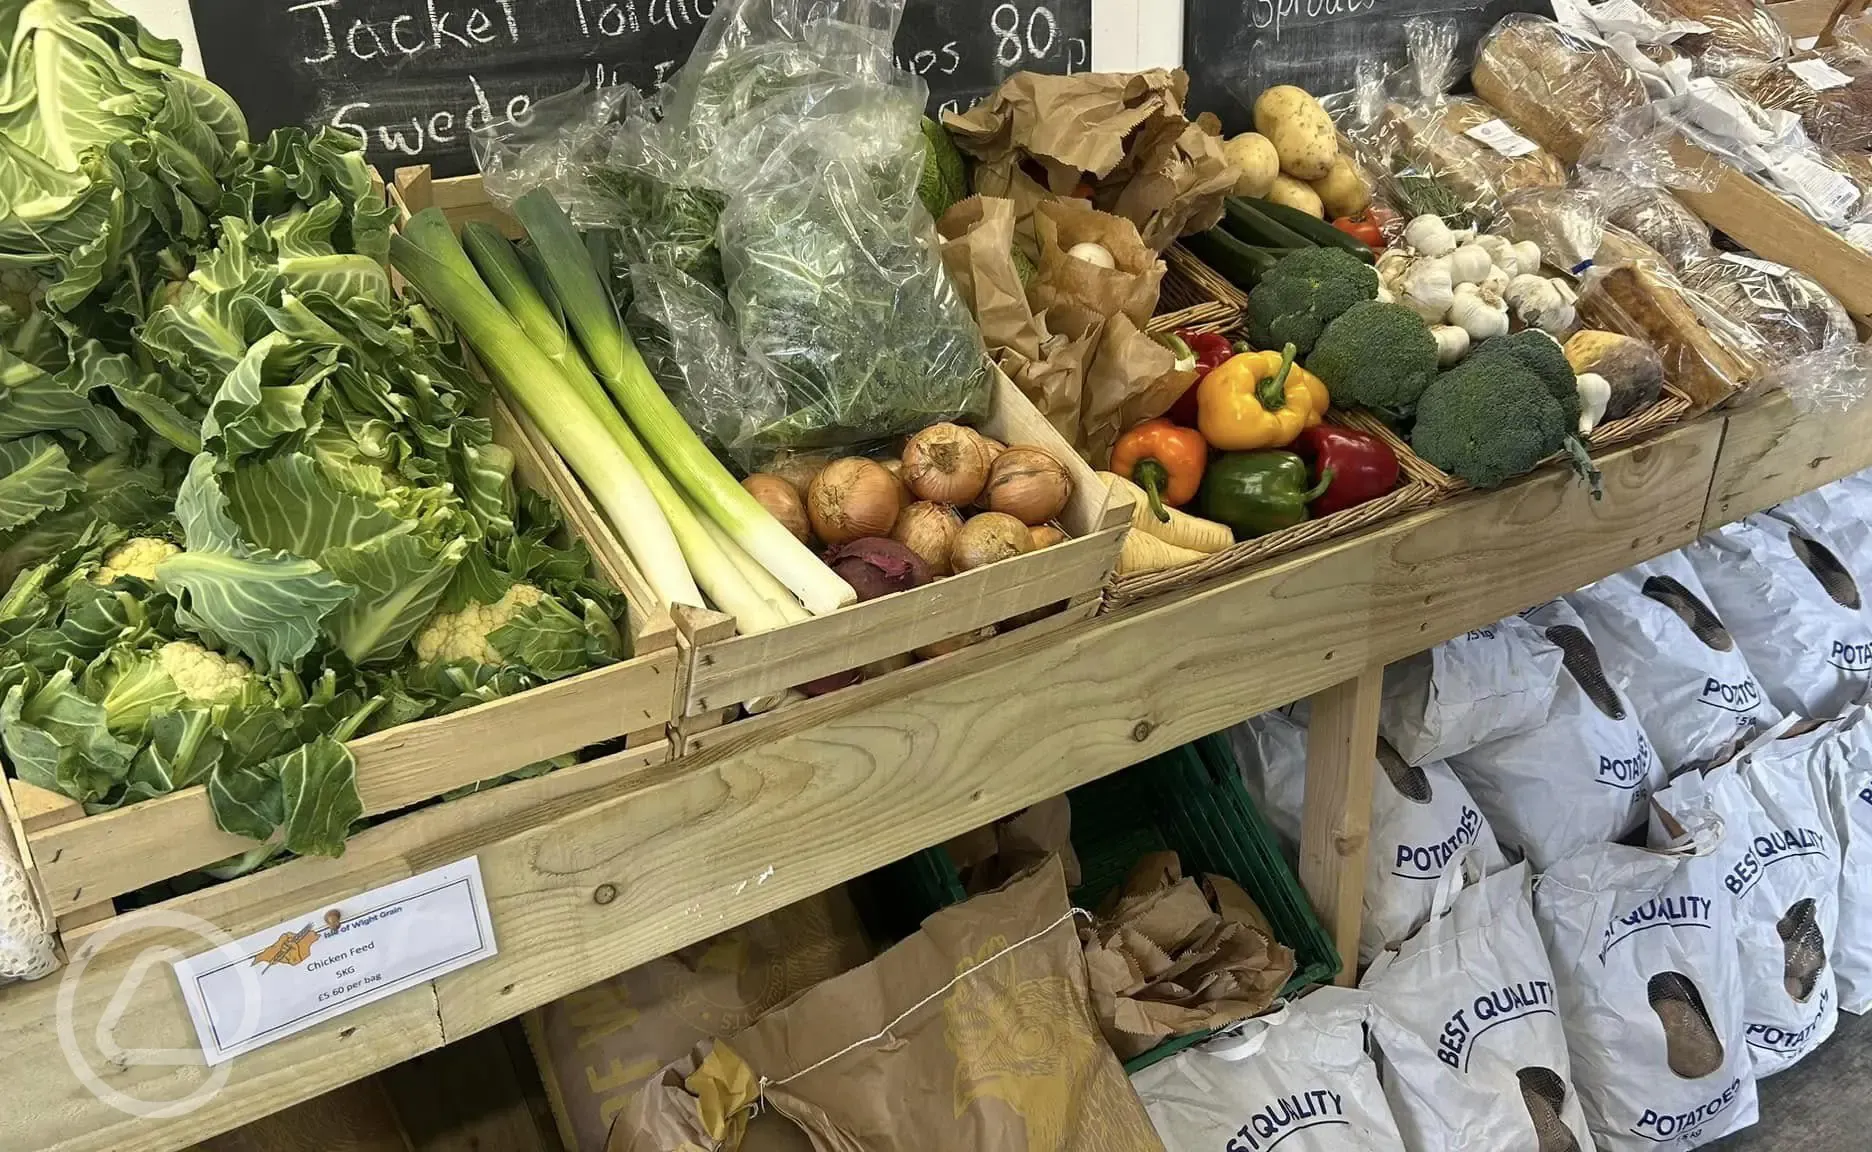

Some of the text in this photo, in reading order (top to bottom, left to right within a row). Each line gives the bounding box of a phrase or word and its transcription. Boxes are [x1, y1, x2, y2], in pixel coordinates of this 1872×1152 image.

[330, 75, 537, 156] Swede
[1831, 640, 1872, 665] POTA
[1395, 804, 1479, 872] POTATOES
[340, 924, 352, 934] of
[351, 915, 379, 929] Wight
[379, 906, 402, 918] Grain
[306, 941, 375, 973] Chicken Feed
[335, 965, 355, 979] 5KG
[346, 979, 362, 993] per
[364, 973, 382, 984] bag
[1437, 980, 1554, 1069] BEST QUALITY
[1251, 1090, 1343, 1139] QUALITY
[1636, 1077, 1741, 1137] POTATOES
